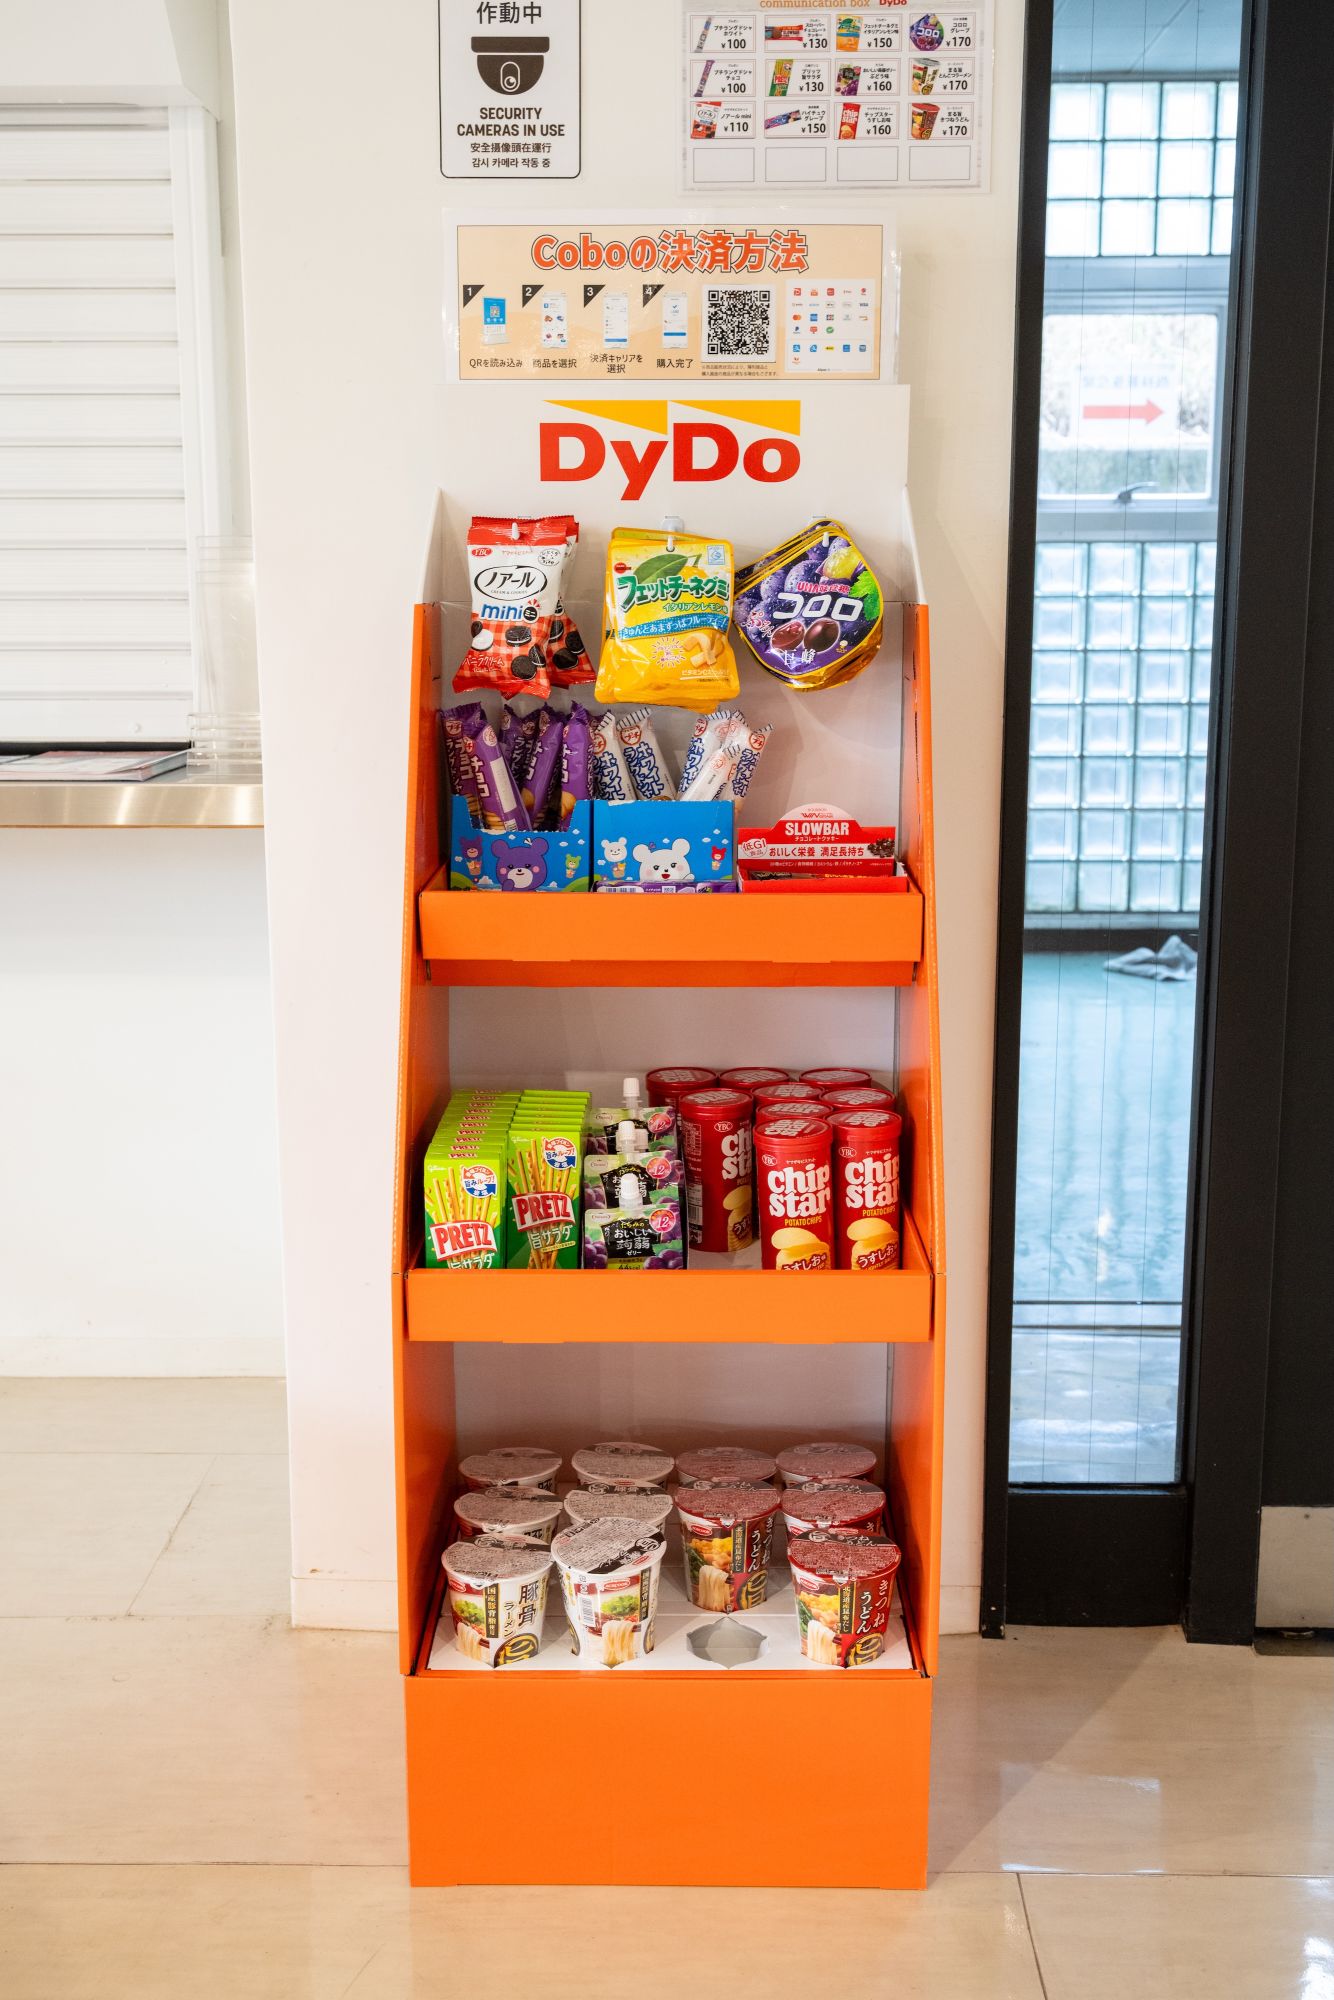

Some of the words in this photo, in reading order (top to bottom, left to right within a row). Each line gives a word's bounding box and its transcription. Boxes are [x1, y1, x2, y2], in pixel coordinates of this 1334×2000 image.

[477, 1, 542, 24] 作動中
[721, 39, 746, 49] ¥100
[803, 38, 828, 49] ¥130
[868, 38, 892, 48] ¥150
[946, 37, 971, 47] ¥170
[721, 83, 746, 93] ¥100
[799, 82, 824, 92] ¥130
[867, 81, 892, 91] ¥160
[943, 80, 968, 91] ¥170
[480, 107, 542, 120] SECURITY
[457, 124, 519, 137] CAMERAS
[523, 124, 536, 136] IN
[540, 124, 565, 137] USE
[724, 122, 749, 132] ¥110
[802, 123, 826, 134] ¥150
[866, 125, 891, 135] ¥160
[943, 126, 967, 136] ¥170
[471, 157, 490, 168] 감시
[492, 157, 519, 168] 카메라
[521, 157, 539, 168] 작동
[542, 157, 551, 168] 중
[531, 229, 809, 274] Coboの決済方法
[467, 287, 473, 296] 1
[525, 287, 532, 296] 2
[586, 287, 593, 296] 3
[645, 286, 653, 296] 4
[469, 357, 523, 368] QRを読み込み
[533, 358, 577, 368] 商品を選択
[590, 353, 643, 363] 決済キャリアを
[656, 358, 694, 369] 購入完了
[607, 363, 626, 373] 選択
[540, 423, 800, 500] DyDo
[484, 571, 536, 590] ノアール
[617, 574, 730, 613] フェットチーネグミ
[481, 604, 523, 620] mini
[772, 592, 864, 622] コロロ
[622, 728, 641, 742] プチ
[751, 735, 766, 749] プチ
[511, 736, 525, 782] ラングドシ
[526, 741, 544, 781] チョコ
[561, 744, 570, 784] チョコ
[598, 751, 626, 800] ホワイト
[623, 747, 656, 799] ラングドシャ
[636, 741, 665, 797] ホワイト
[470, 755, 490, 798] チョコ
[785, 822, 850, 836] SLOWBAR
[742, 837, 767, 851] 低GI
[769, 846, 816, 857] おいしく栄養
[820, 846, 865, 857] 満足長持ち
[716, 1123, 731, 1131] YBC
[721, 1128, 752, 1157] ch
[841, 1148, 855, 1157] YBC
[763, 1156, 776, 1165] YBC
[653, 1165, 665, 1176] 12
[845, 1152, 899, 1185] chip
[767, 1162, 830, 1194] chip
[769, 1187, 831, 1218] star
[516, 1195, 571, 1225] PRETZ
[862, 1208, 883, 1217] POTATO
[883, 1206, 896, 1215] CHIPS
[656, 1217, 669, 1229] 12
[784, 1218, 806, 1226] POTATO
[806, 1216, 823, 1225] CHIPS
[434, 1223, 492, 1255] PRETZ
[530, 1224, 574, 1249] 旨サラダ
[616, 1236, 650, 1250] 蒟蒻
[748, 1530, 761, 1572] うどん
[518, 1580, 539, 1627] 豚骨
[872, 1579, 889, 1628] きつね
[504, 1601, 515, 1637] ラーメン
[856, 1591, 872, 1634] うどん
